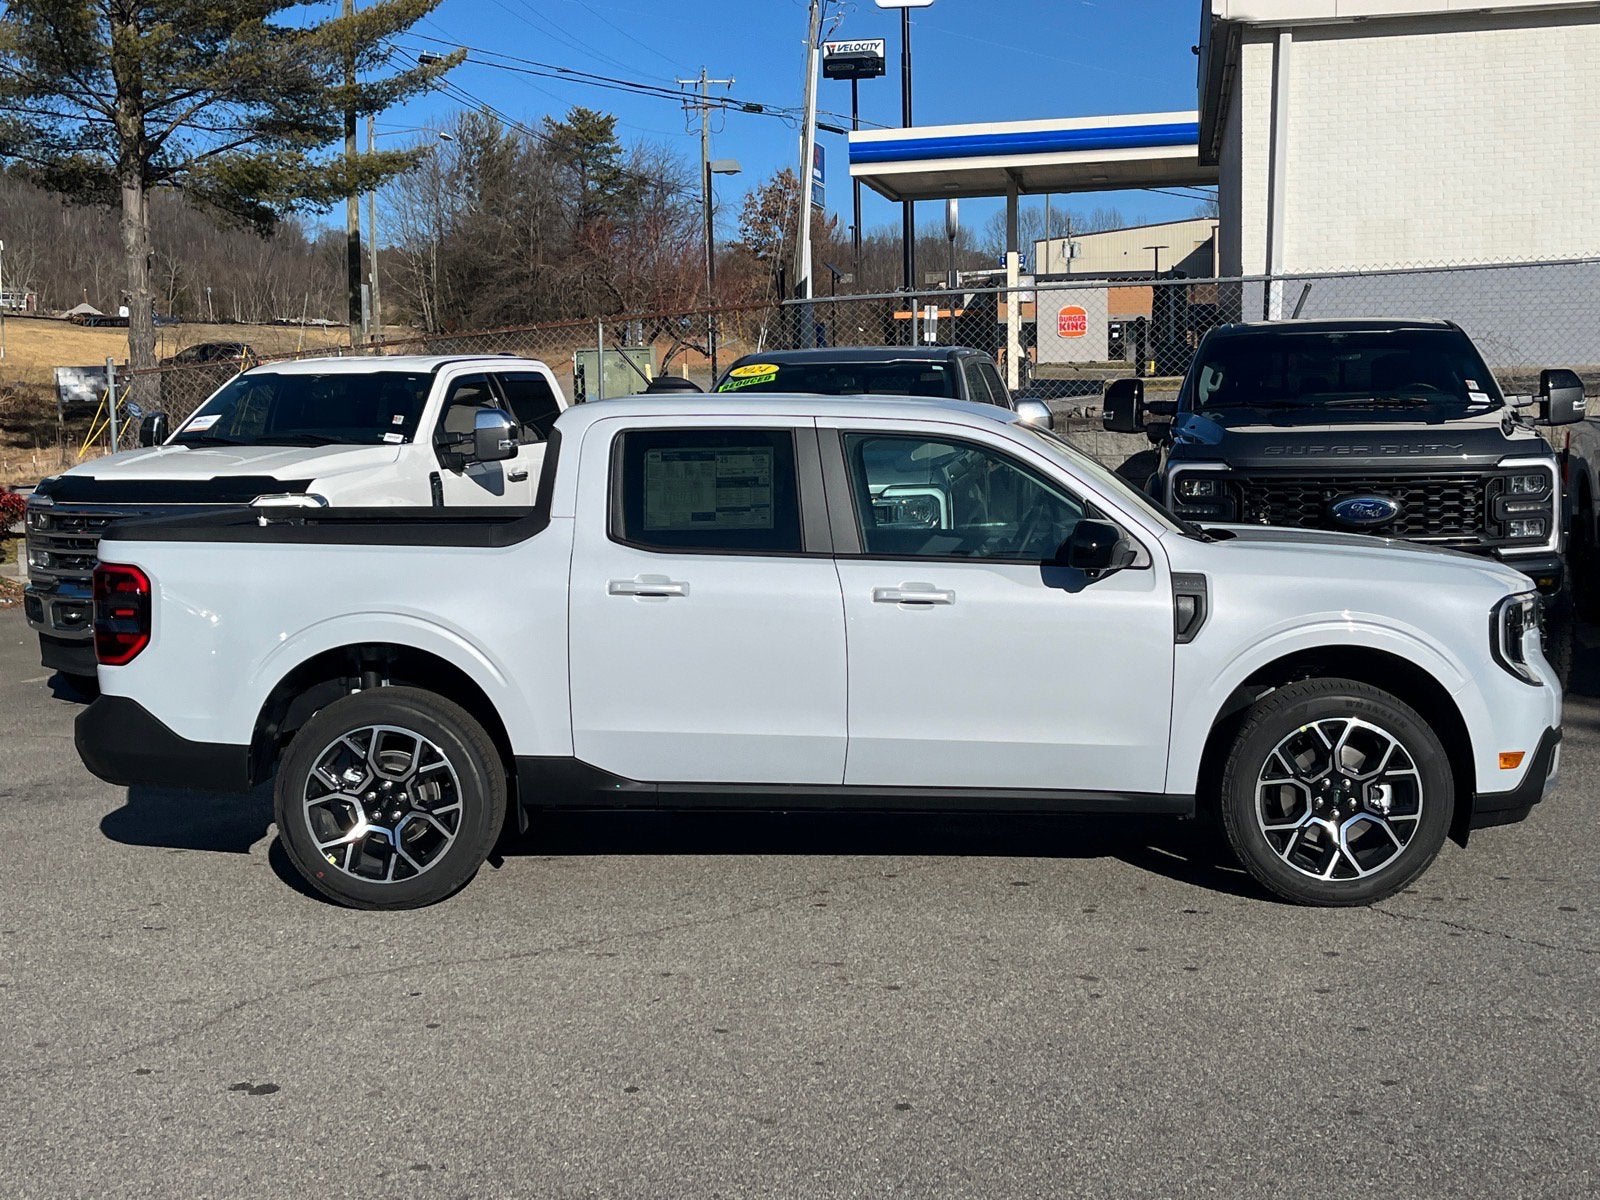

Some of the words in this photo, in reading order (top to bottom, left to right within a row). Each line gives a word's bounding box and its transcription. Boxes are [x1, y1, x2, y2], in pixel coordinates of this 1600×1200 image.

[837, 42, 881, 51] VELOCITY
[1059, 322, 1086, 331] KING
[1264, 445, 1373, 456] SUPER
[1380, 443, 1464, 455] DUTY
[1351, 502, 1382, 518] Ford
